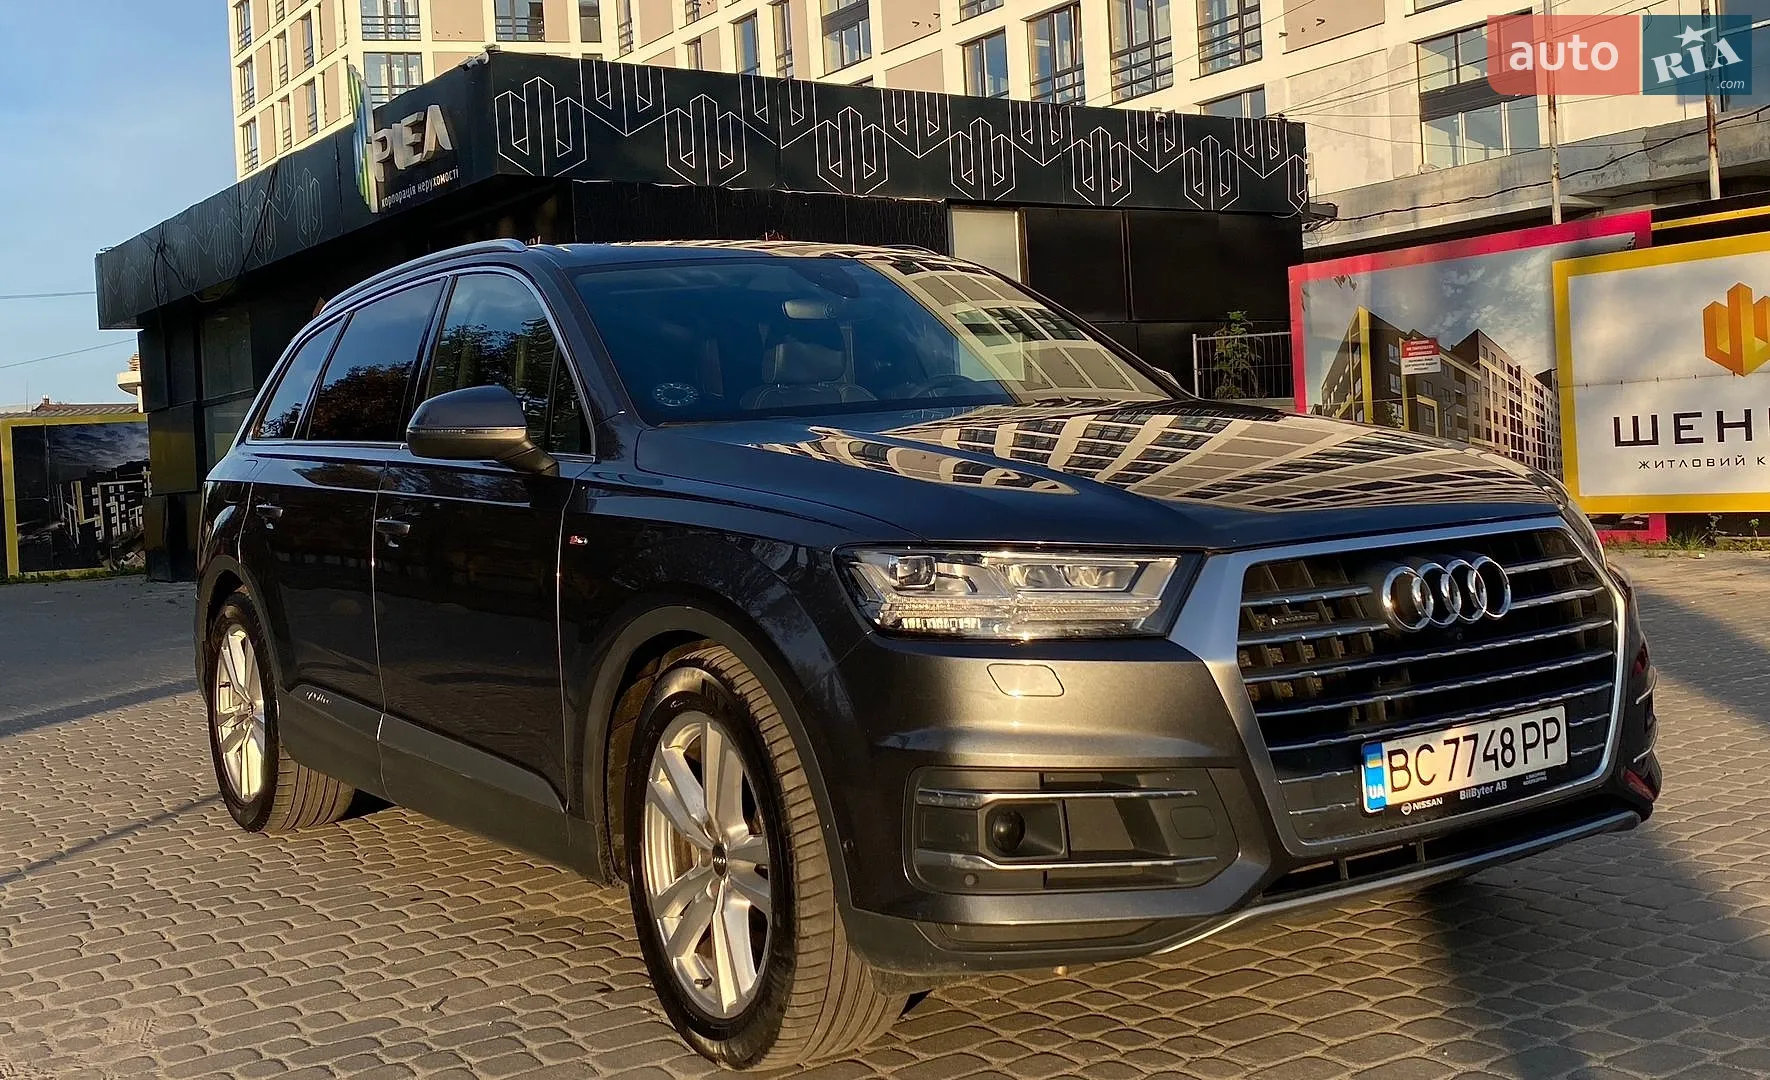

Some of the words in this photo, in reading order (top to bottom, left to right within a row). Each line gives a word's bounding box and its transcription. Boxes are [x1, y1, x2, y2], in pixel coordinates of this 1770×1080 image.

[381, 184, 416, 209] корпорація
[417, 165, 459, 196] нерухомості
[1613, 407, 1770, 447] ШЕН
[1638, 454, 1746, 470] ЖИТЛОВИЙ
[1387, 743, 1437, 793] BC
[1443, 726, 1517, 782] 7748
[1521, 716, 1561, 765] PP
[1368, 783, 1386, 800] UA
[1412, 797, 1443, 811] NISSAN
[1459, 783, 1494, 800] BilByter
[1495, 780, 1508, 792] AB
